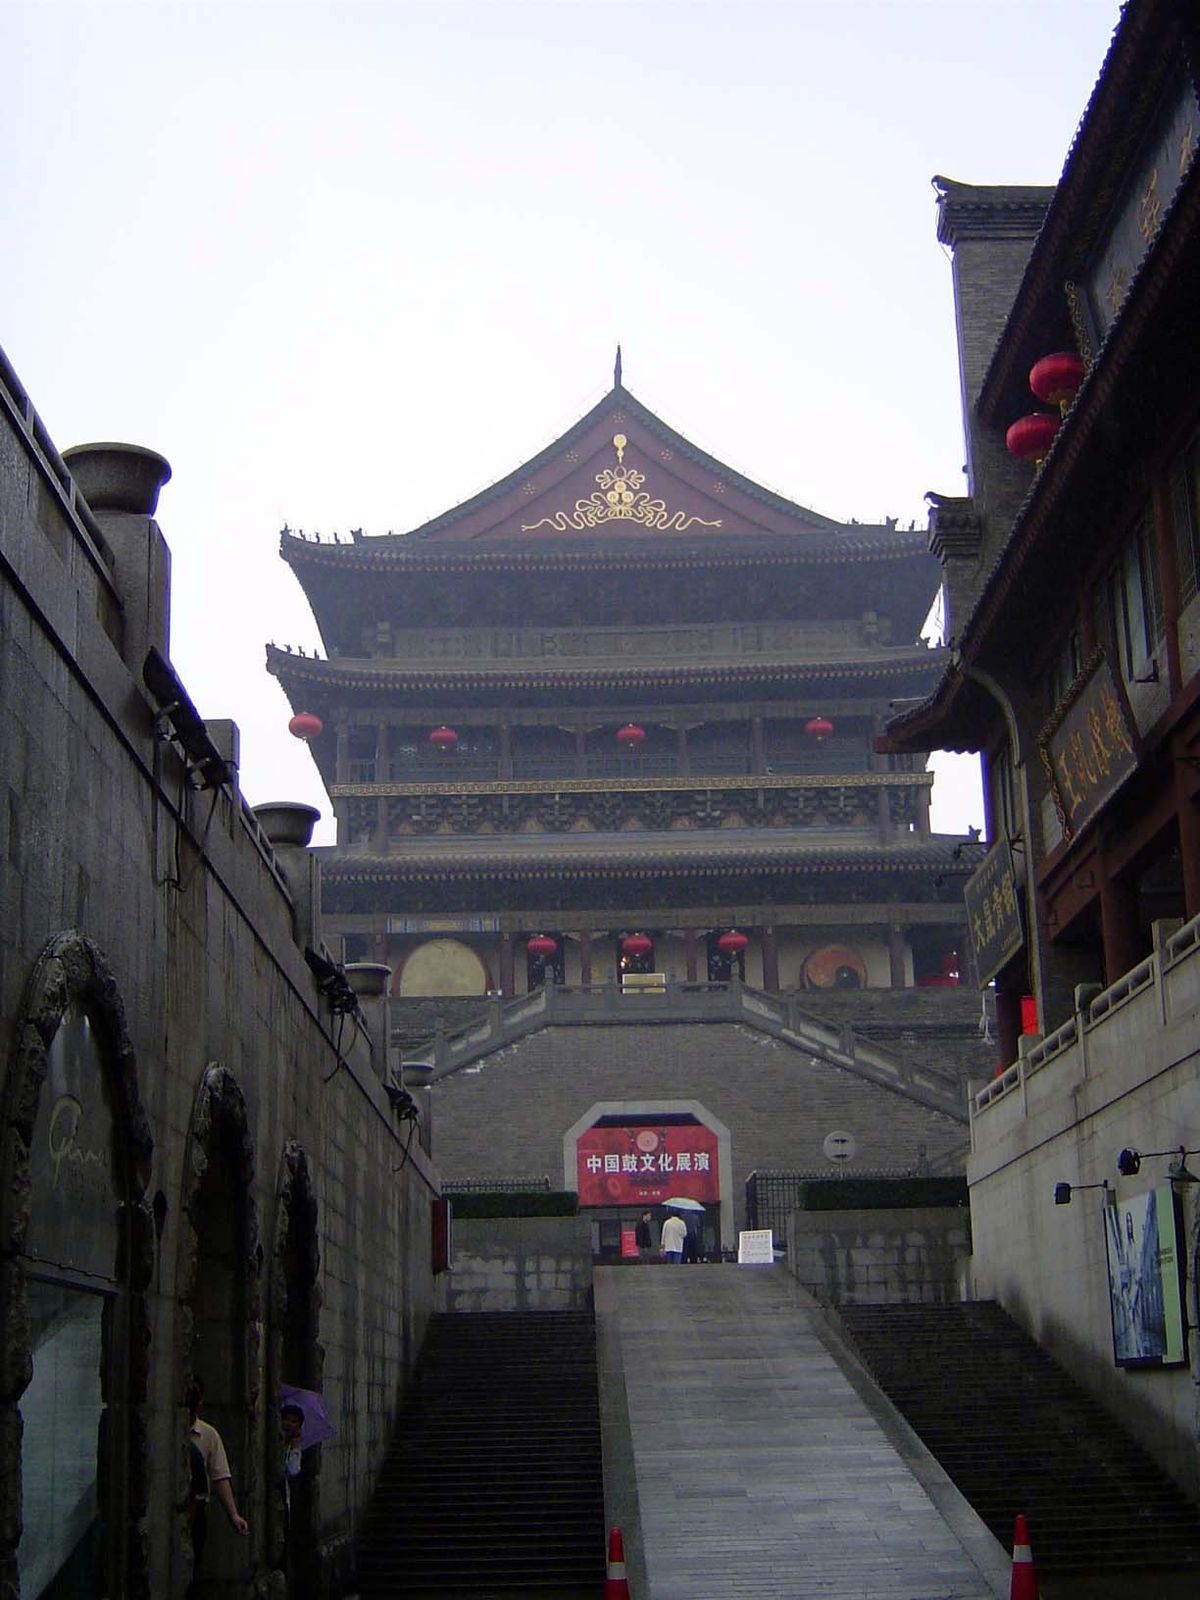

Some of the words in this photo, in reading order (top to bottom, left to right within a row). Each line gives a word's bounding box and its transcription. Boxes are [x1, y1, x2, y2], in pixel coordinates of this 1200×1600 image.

[586, 1152, 710, 1174] 中国鼓文化展演
